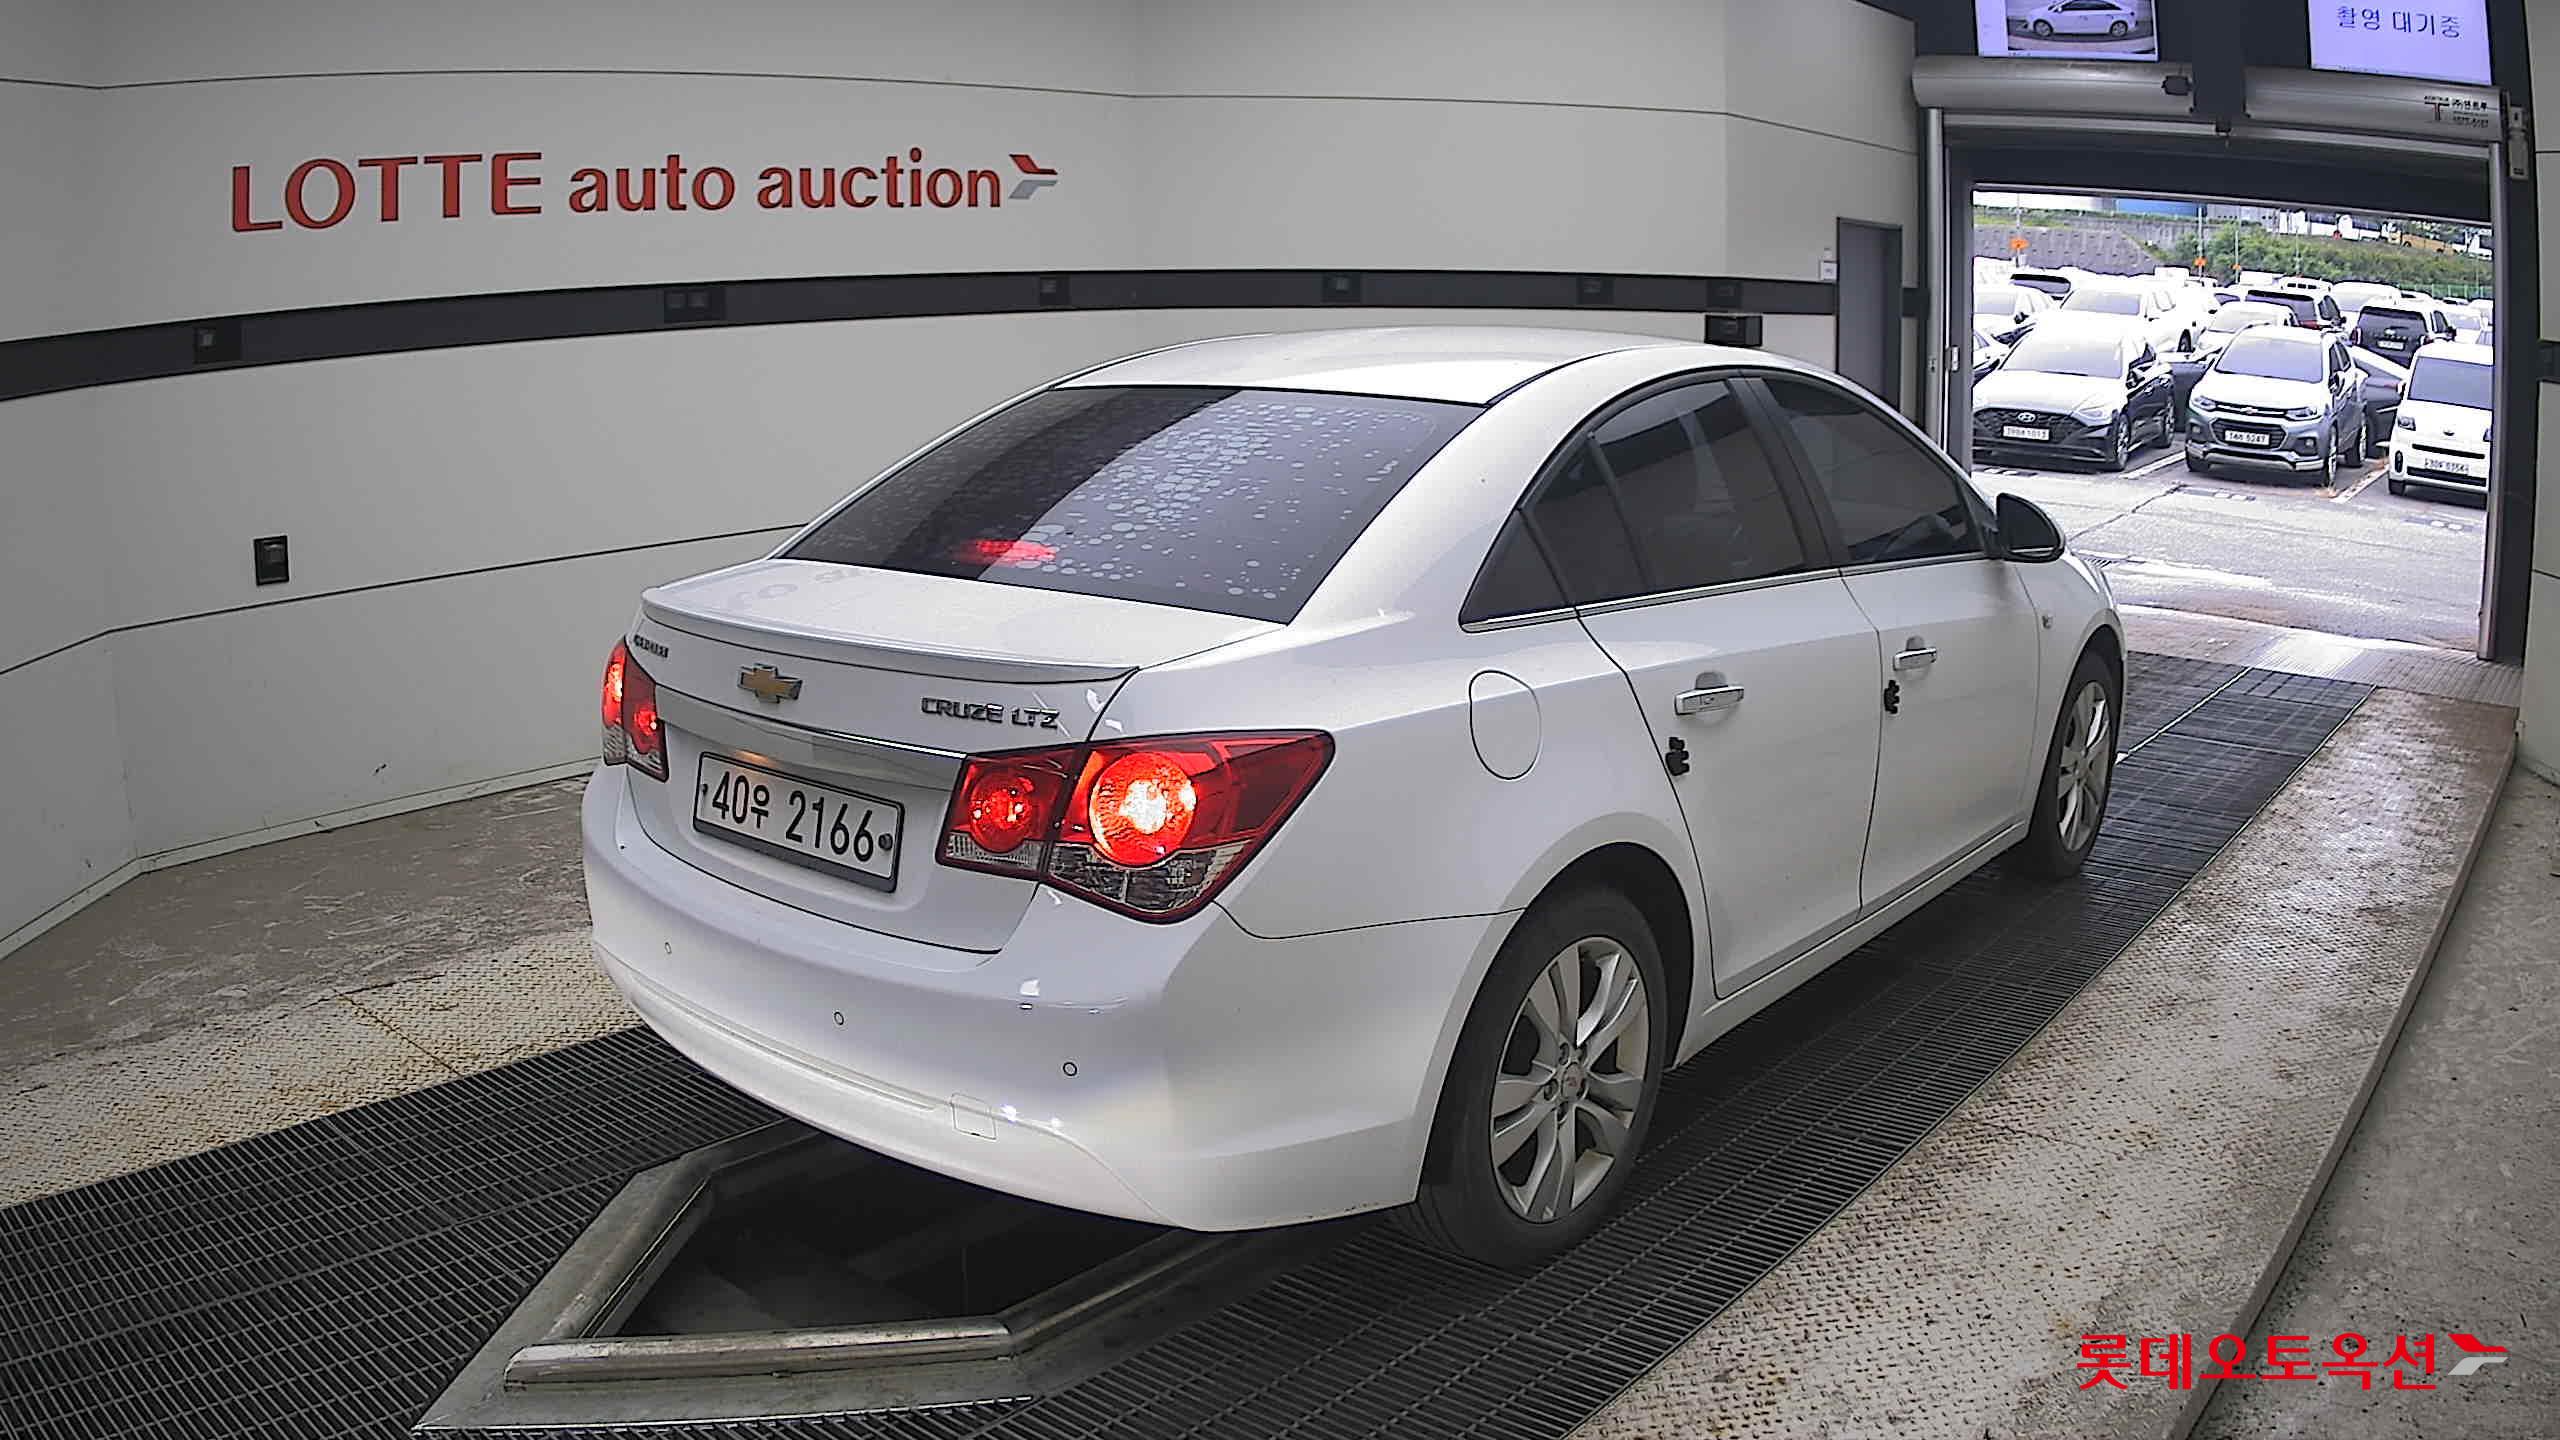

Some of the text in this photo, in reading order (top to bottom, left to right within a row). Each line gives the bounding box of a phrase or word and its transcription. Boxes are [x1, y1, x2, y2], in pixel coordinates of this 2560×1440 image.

[2336, 6, 2461, 39] 촬영 대기중
[231, 147, 1001, 233] LOTTE auto auction
[920, 696, 1061, 730] CRUZE LTZ
[712, 770, 875, 863] 40우 2166
